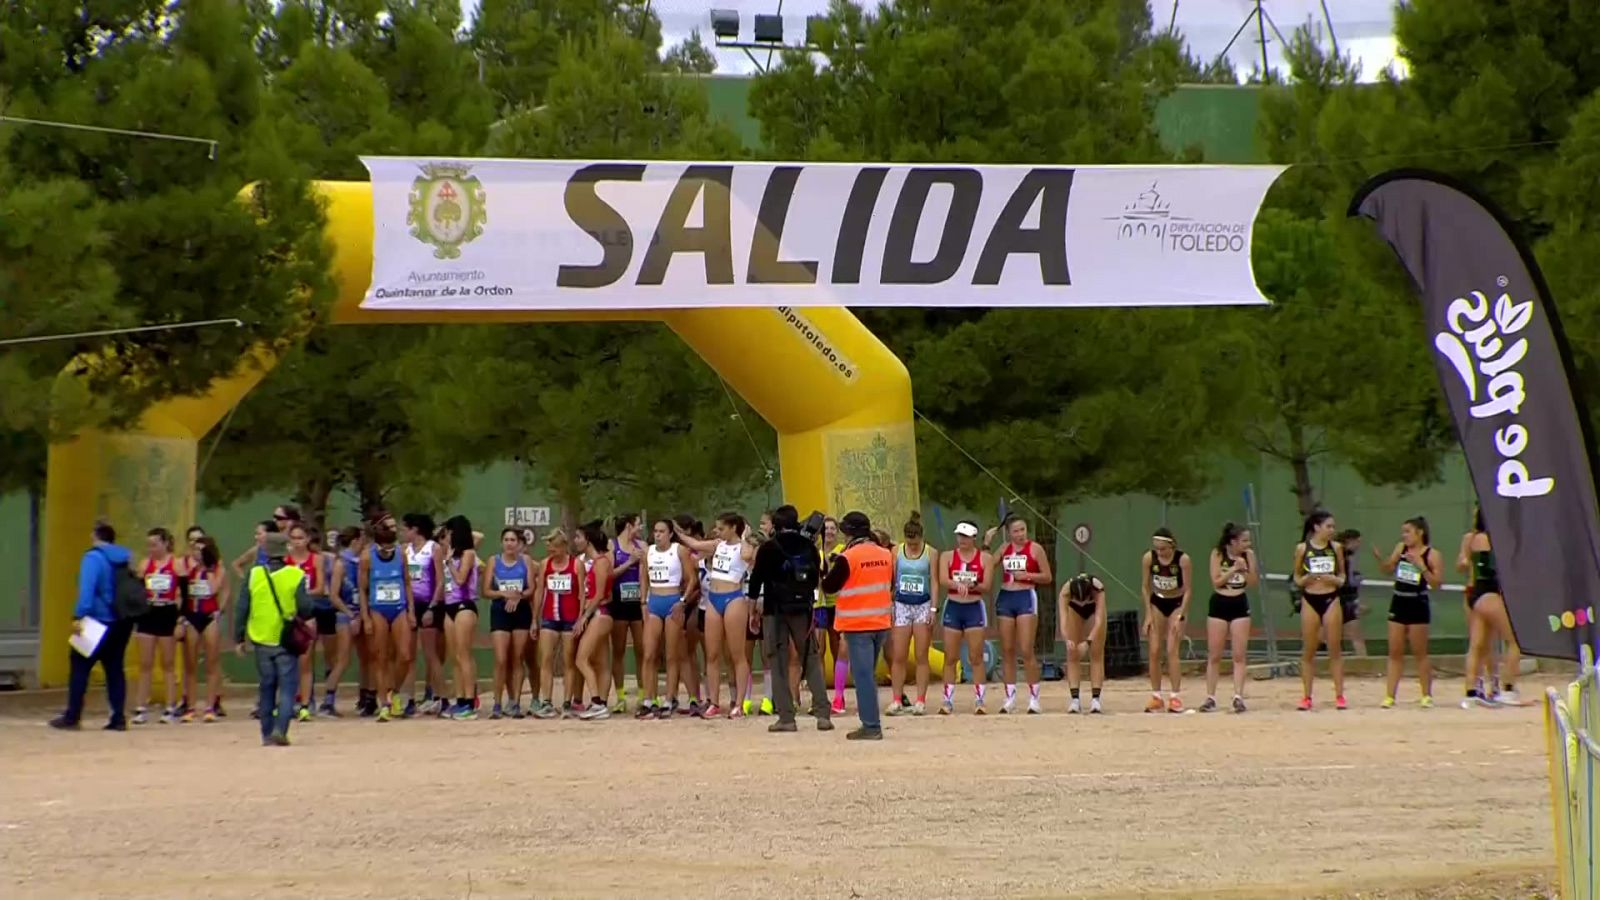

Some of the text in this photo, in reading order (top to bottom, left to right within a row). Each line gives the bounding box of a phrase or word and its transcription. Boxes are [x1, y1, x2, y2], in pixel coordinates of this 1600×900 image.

[556, 163, 1076, 288] SALIDA
[1232, 224, 1246, 234] DE
[1169, 234, 1245, 252] TOLEDO
[407, 270, 486, 284] Ayuntamiento
[374, 285, 514, 299] Quintanar de la Orden
[507, 509, 547, 523] FALTA
[717, 560, 724, 569] 12
[1008, 561, 1021, 569] 413
[654, 571, 662, 579] 11
[551, 580, 565, 589] 371
